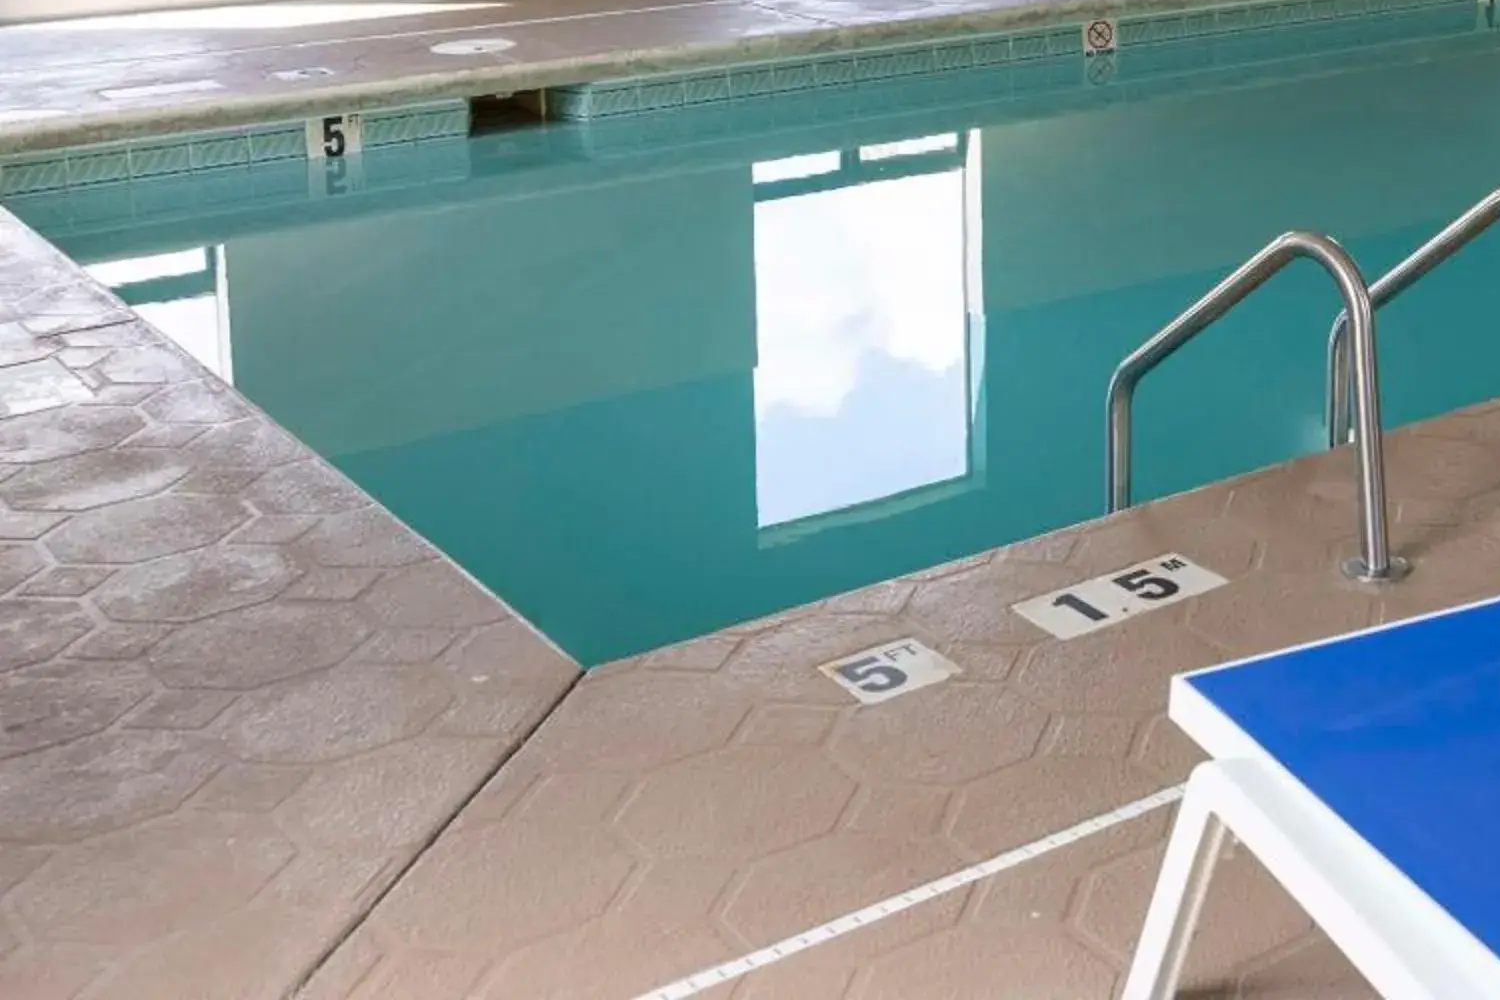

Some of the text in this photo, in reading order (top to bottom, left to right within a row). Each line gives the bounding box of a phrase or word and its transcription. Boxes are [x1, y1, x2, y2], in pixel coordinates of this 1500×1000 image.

[323, 115, 345, 157] 5
[1160, 557, 1187, 572] M
[837, 643, 917, 693] 5 FT
